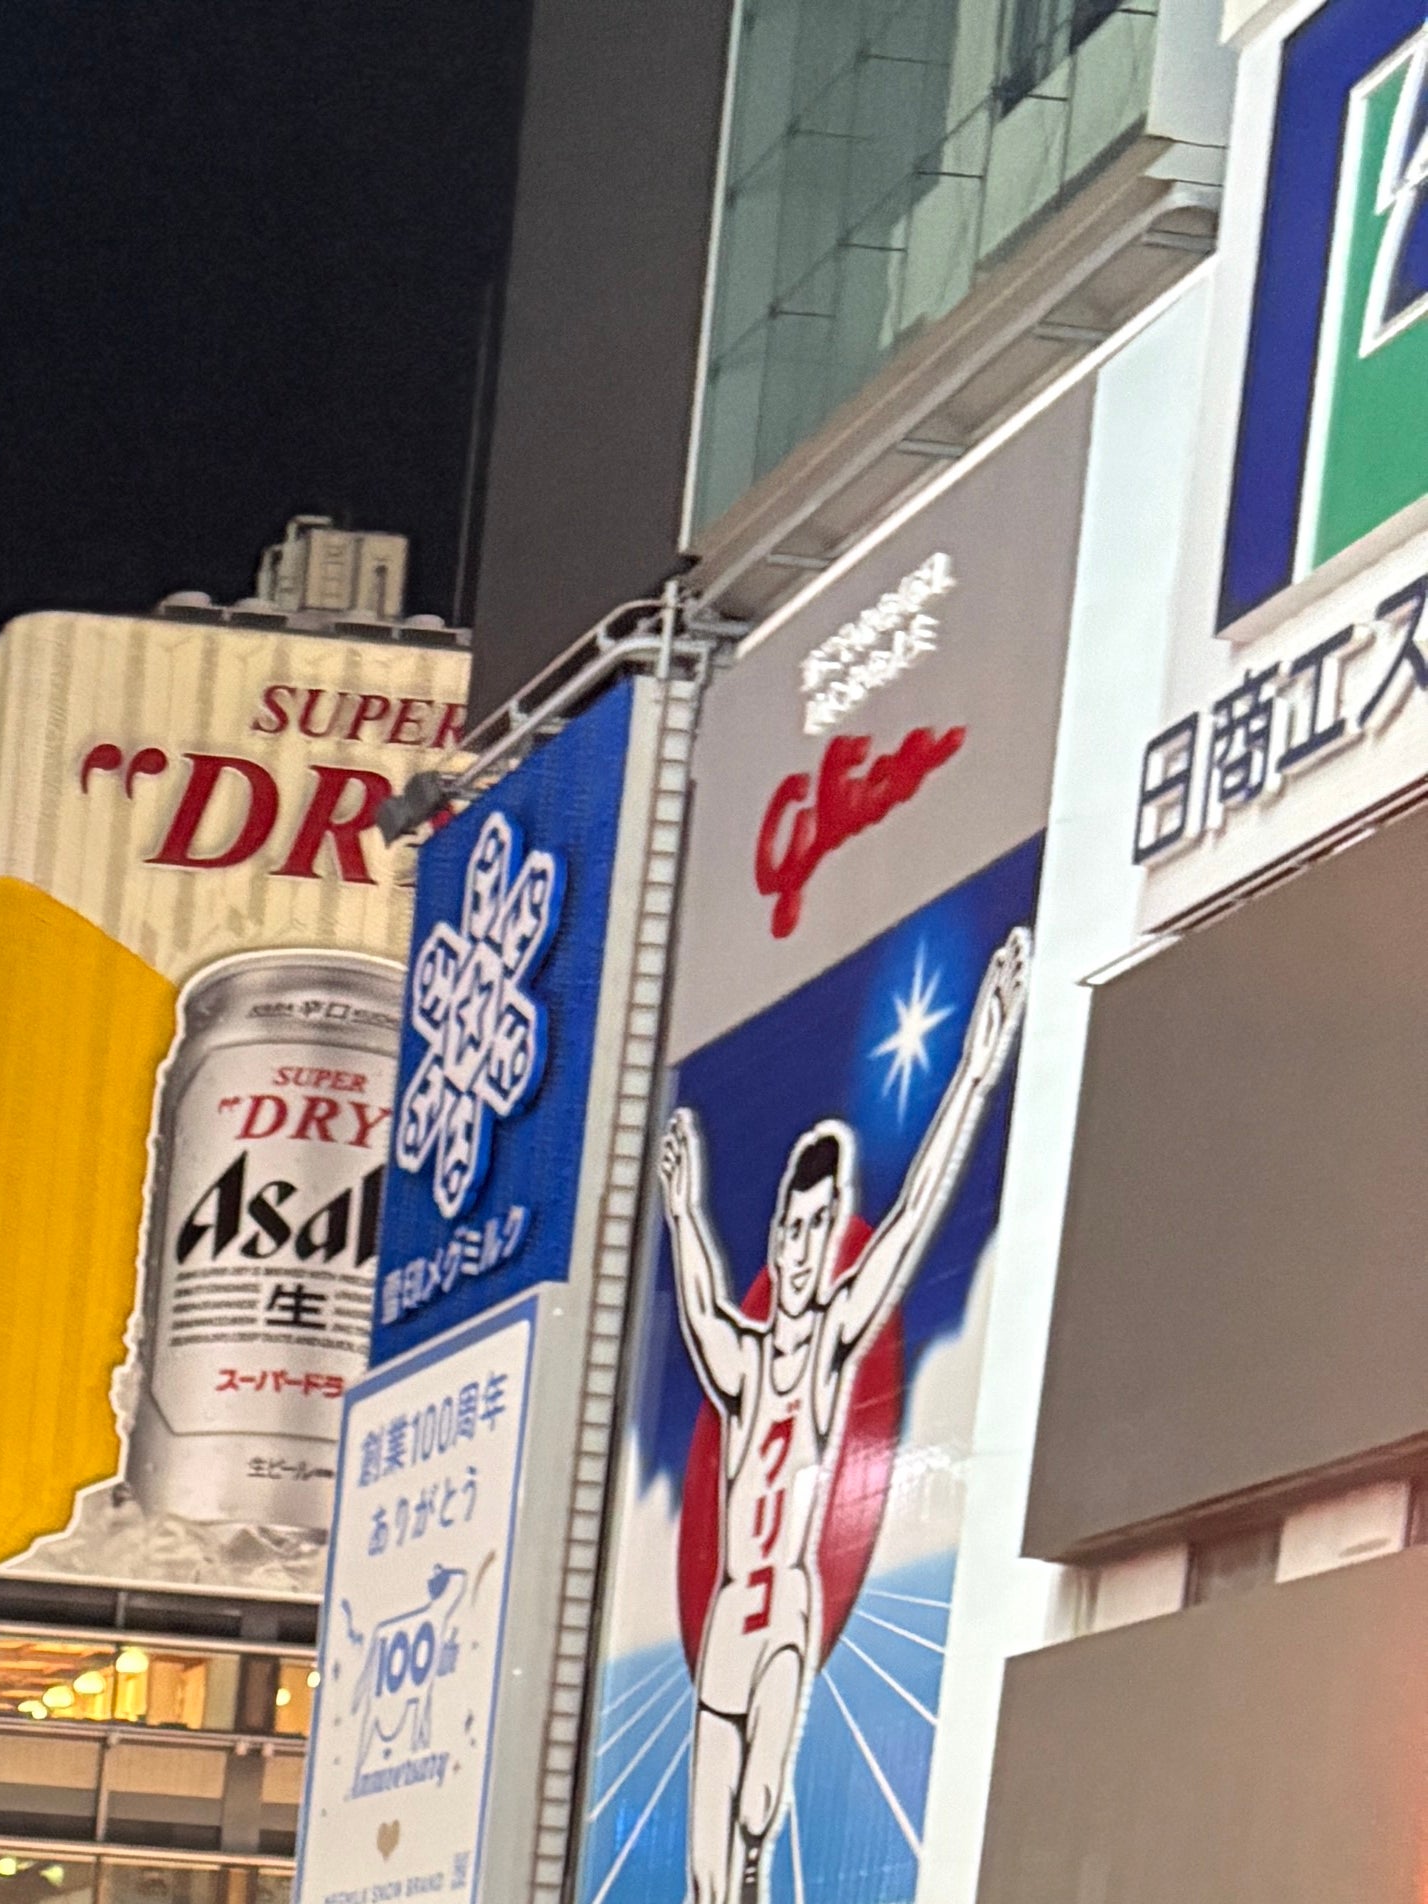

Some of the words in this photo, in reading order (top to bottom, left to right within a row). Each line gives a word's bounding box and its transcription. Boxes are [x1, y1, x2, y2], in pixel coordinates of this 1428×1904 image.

[273, 1066, 368, 1093] SUPER
[176, 1150, 385, 1268] Asa
[265, 1283, 327, 1330] 生
[368, 1465, 480, 1558] ありがとう
[741, 1397, 802, 1637] グリコ
